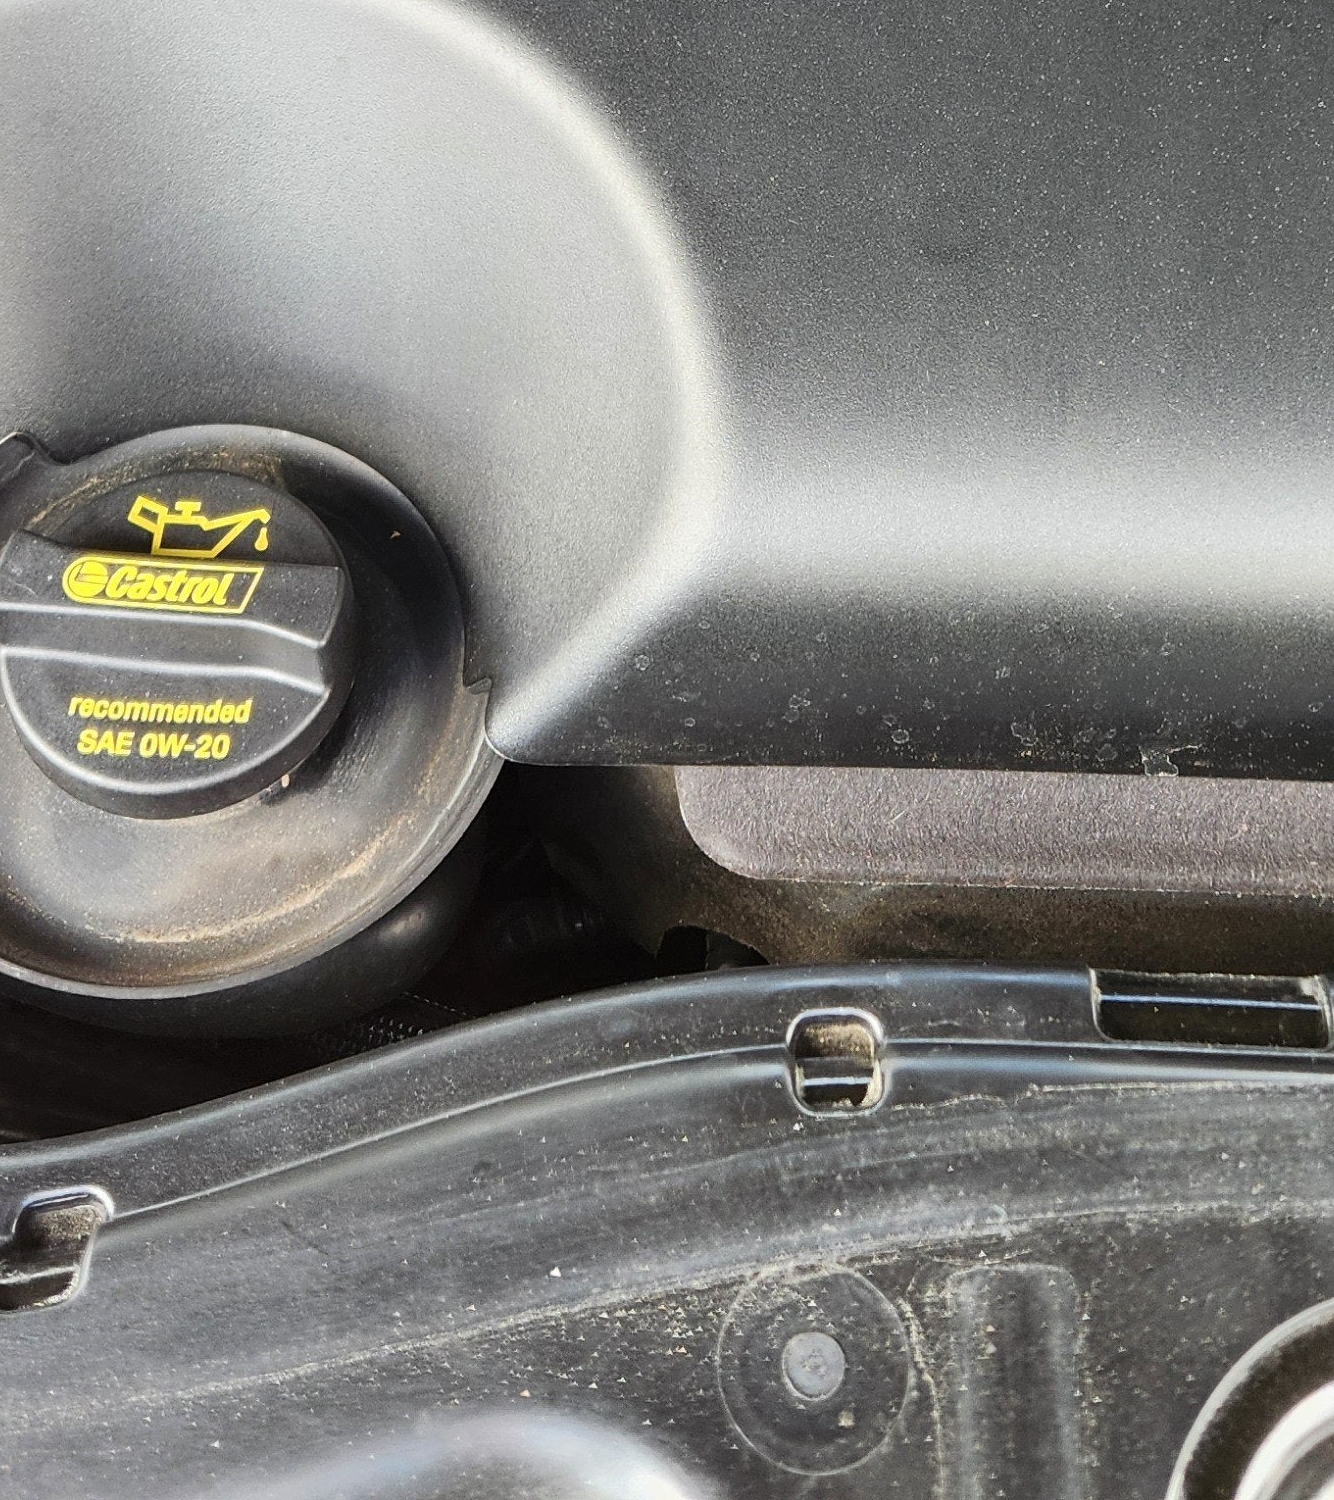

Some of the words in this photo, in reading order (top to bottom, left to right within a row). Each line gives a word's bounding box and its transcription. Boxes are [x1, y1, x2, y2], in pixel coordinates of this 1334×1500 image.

[105, 565, 235, 606] Castrol
[68, 696, 254, 725] recommended
[77, 729, 135, 757] SAE
[139, 732, 231, 760] 0W-20
